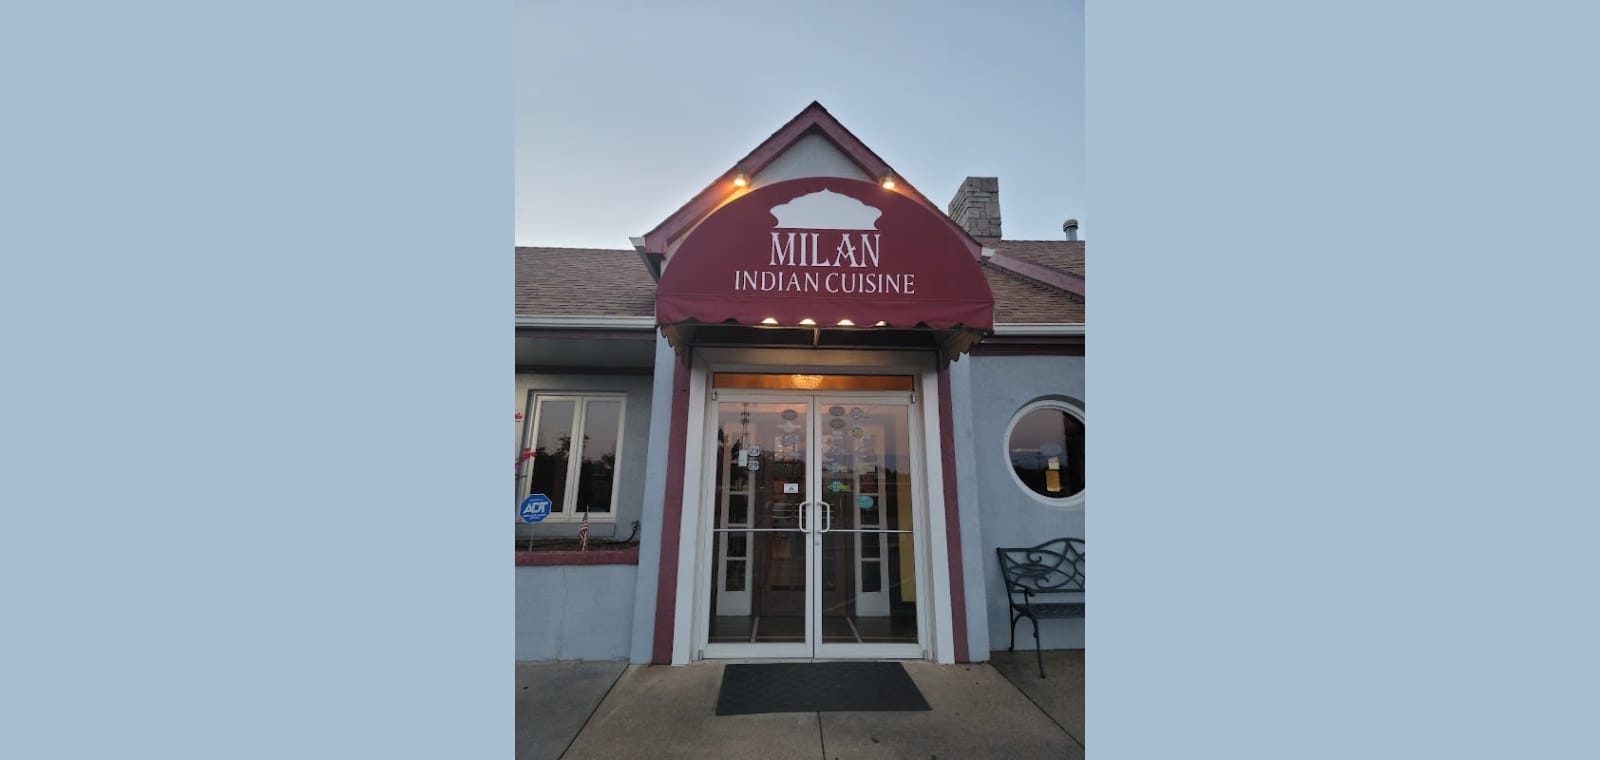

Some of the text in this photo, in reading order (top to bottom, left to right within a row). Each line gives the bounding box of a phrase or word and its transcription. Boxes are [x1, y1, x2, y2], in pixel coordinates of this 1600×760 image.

[769, 232, 880, 267] MILAN
[735, 270, 915, 294] INDIAN CUISINE
[523, 501, 548, 513] ADT
